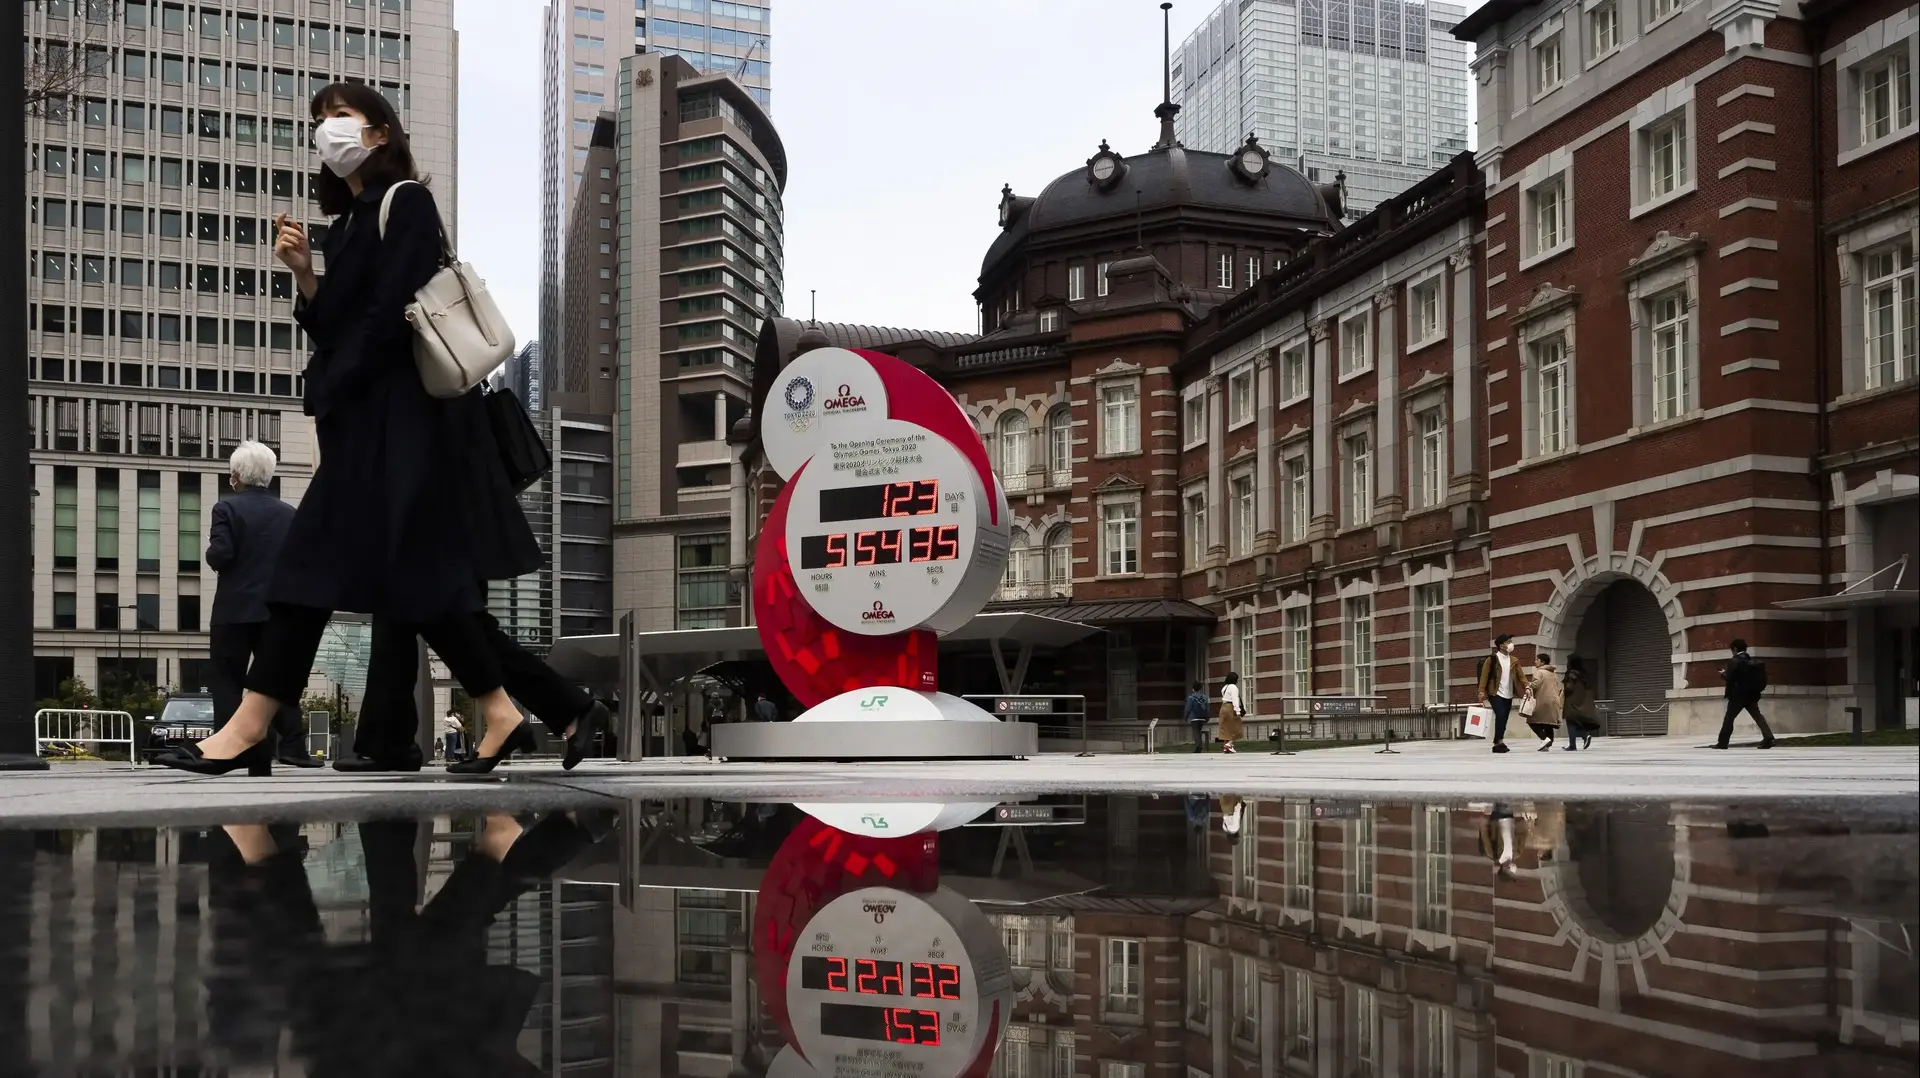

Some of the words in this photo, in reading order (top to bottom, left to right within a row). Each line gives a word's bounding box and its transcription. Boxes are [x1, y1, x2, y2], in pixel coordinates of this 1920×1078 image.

[824, 396, 865, 409] OMEGA
[784, 411, 801, 420] TOKYO
[849, 440, 874, 448] Opening
[875, 437, 906, 445] Ceremony
[833, 450, 858, 459] Olympic
[860, 448, 880, 456] Games
[882, 445, 900, 453] Tokyo
[901, 443, 917, 451] 2020
[882, 479, 938, 517] 123
[945, 491, 965, 501] DAYS
[825, 533, 848, 568] 5
[855, 529, 902, 566] 54
[911, 524, 959, 562] 35
[869, 569, 886, 577] MINS
[926, 565, 944, 574] SECS
[862, 610, 895, 620] OMEGA
[860, 695, 888, 707] JR
